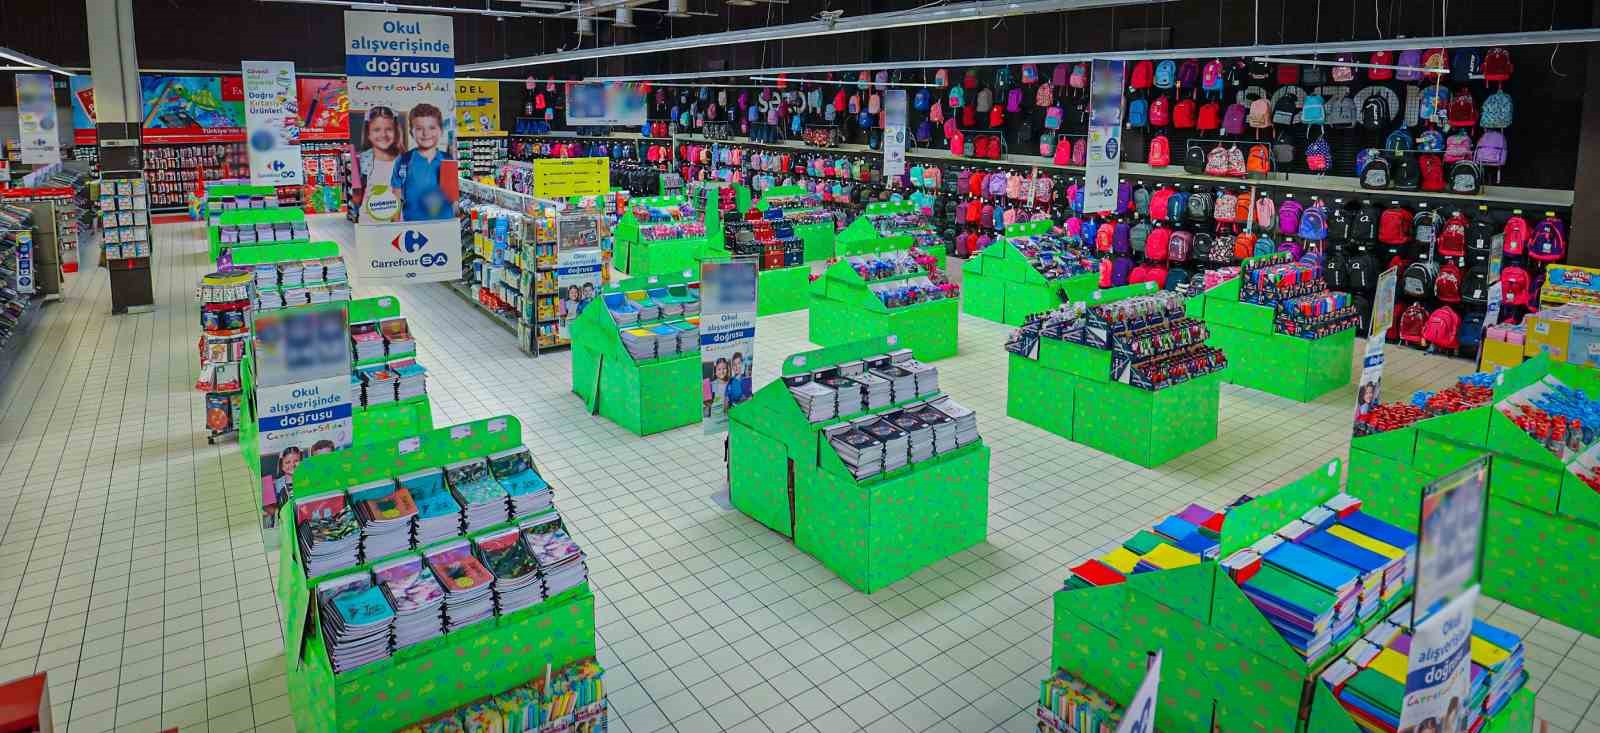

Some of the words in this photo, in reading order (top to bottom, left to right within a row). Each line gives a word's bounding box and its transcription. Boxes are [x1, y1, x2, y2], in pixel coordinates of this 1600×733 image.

[384, 21, 421, 34] Okul
[351, 36, 450, 54] alışverişinde
[366, 57, 440, 75] doğrusu
[291, 386, 320, 399] Okul
[270, 394, 341, 413] alışverişinde
[280, 410, 333, 427] doğrusu
